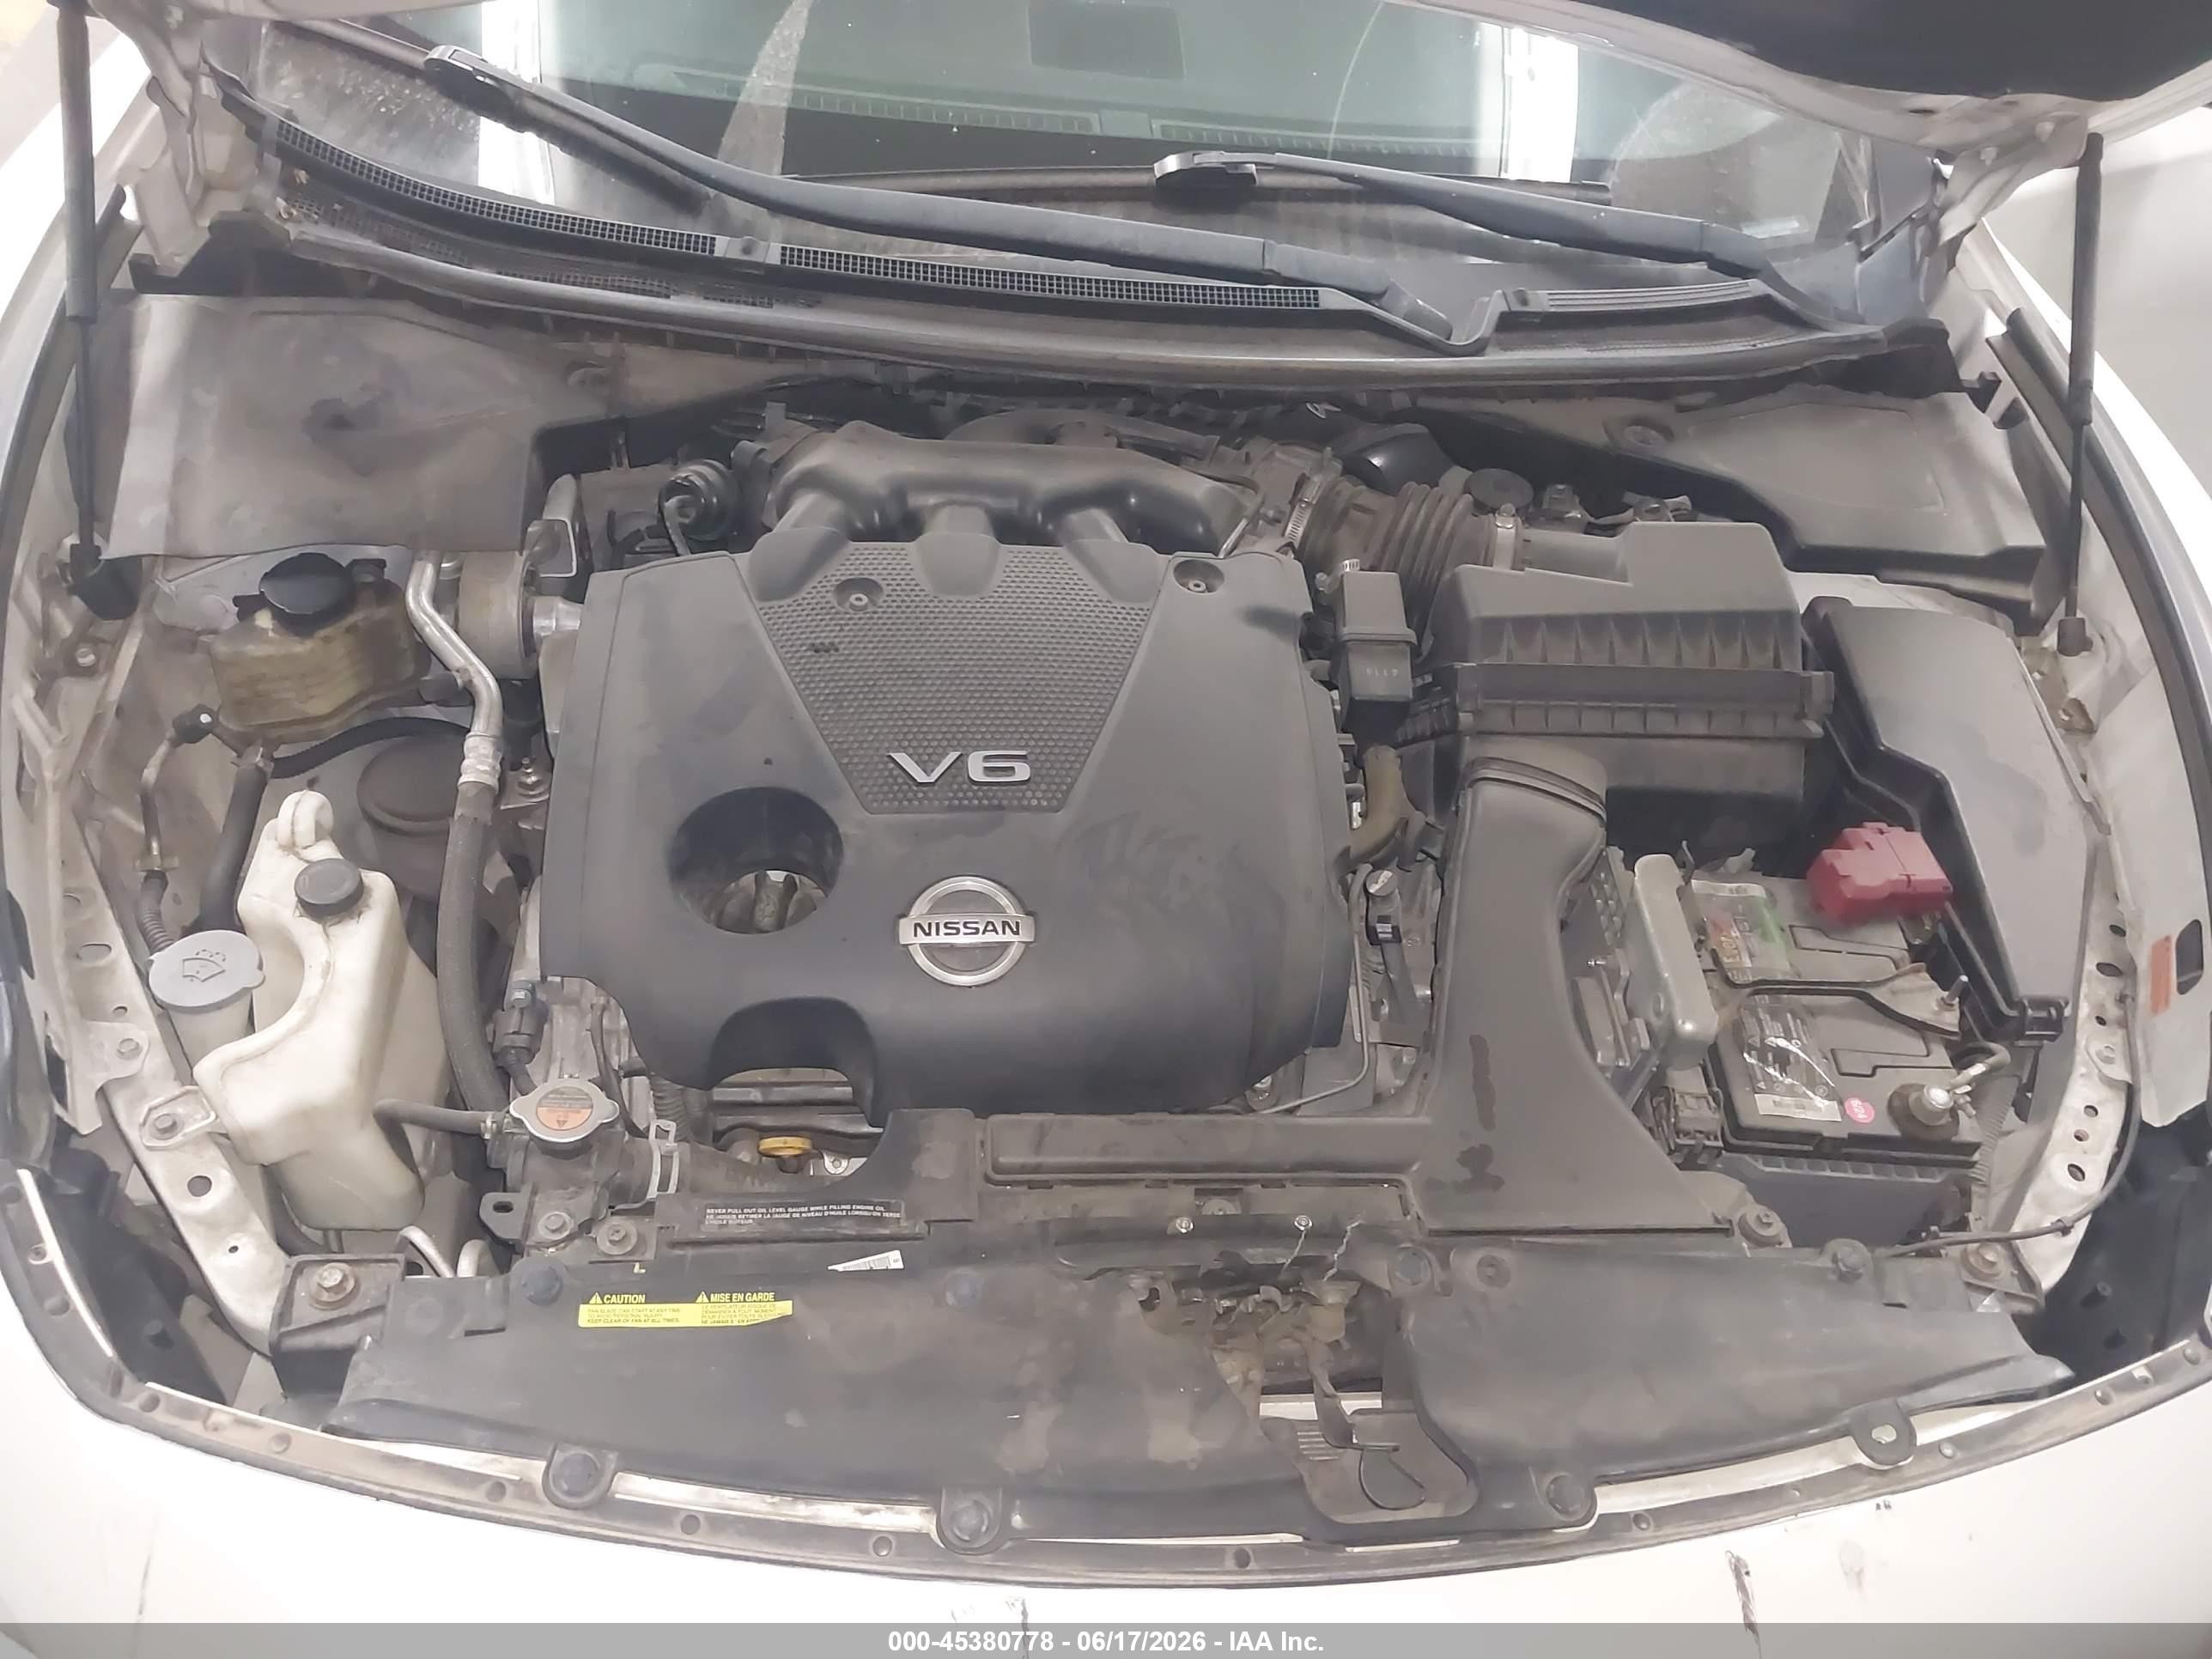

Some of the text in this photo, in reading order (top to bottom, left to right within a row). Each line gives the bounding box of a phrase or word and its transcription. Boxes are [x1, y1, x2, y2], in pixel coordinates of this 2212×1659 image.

[888, 750, 1031, 783] V6
[912, 918, 1022, 938] NISSAN
[603, 1294, 646, 1304] CAUTION
[710, 1291, 775, 1303] MISE EN GARDE
